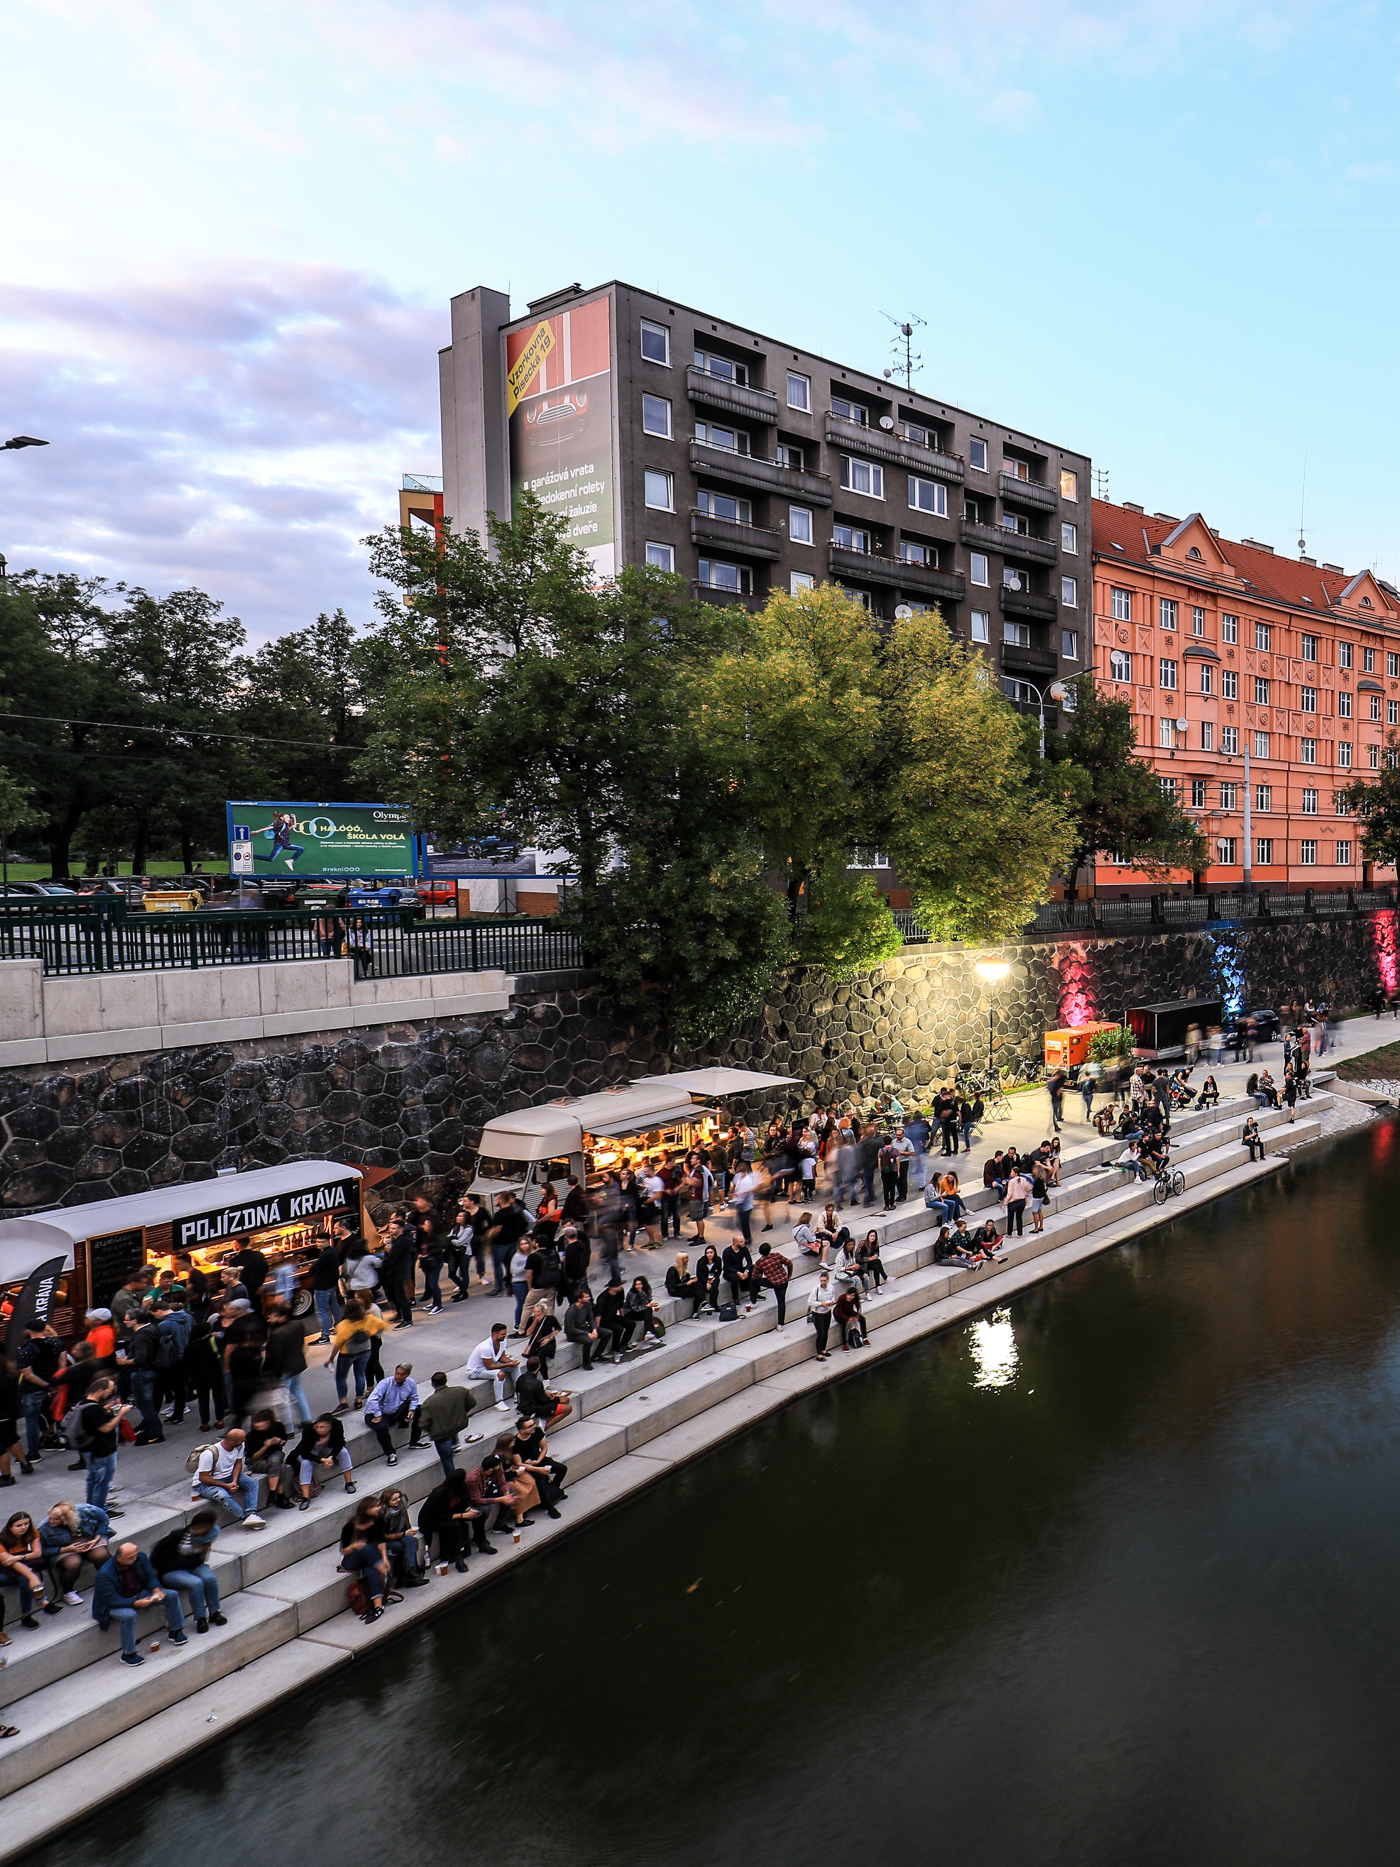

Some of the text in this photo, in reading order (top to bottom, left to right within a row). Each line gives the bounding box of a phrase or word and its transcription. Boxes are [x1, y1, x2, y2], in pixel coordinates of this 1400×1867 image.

[508, 327, 546, 386] Vzorkovna
[513, 335, 551, 399] Písecká 19
[531, 463, 595, 491] garážová vrata
[536, 481, 605, 506] ředokenní rolety
[568, 501, 598, 518] žaluzie
[572, 520, 598, 537] dveře
[320, 824, 363, 833] HALÓÓÓ,
[346, 832, 378, 840] ŠKOLA
[181, 1198, 281, 1246] POJÍZDNÁ
[290, 1185, 346, 1218] KRÁVA
[35, 1276, 55, 1313] KRÁVA
